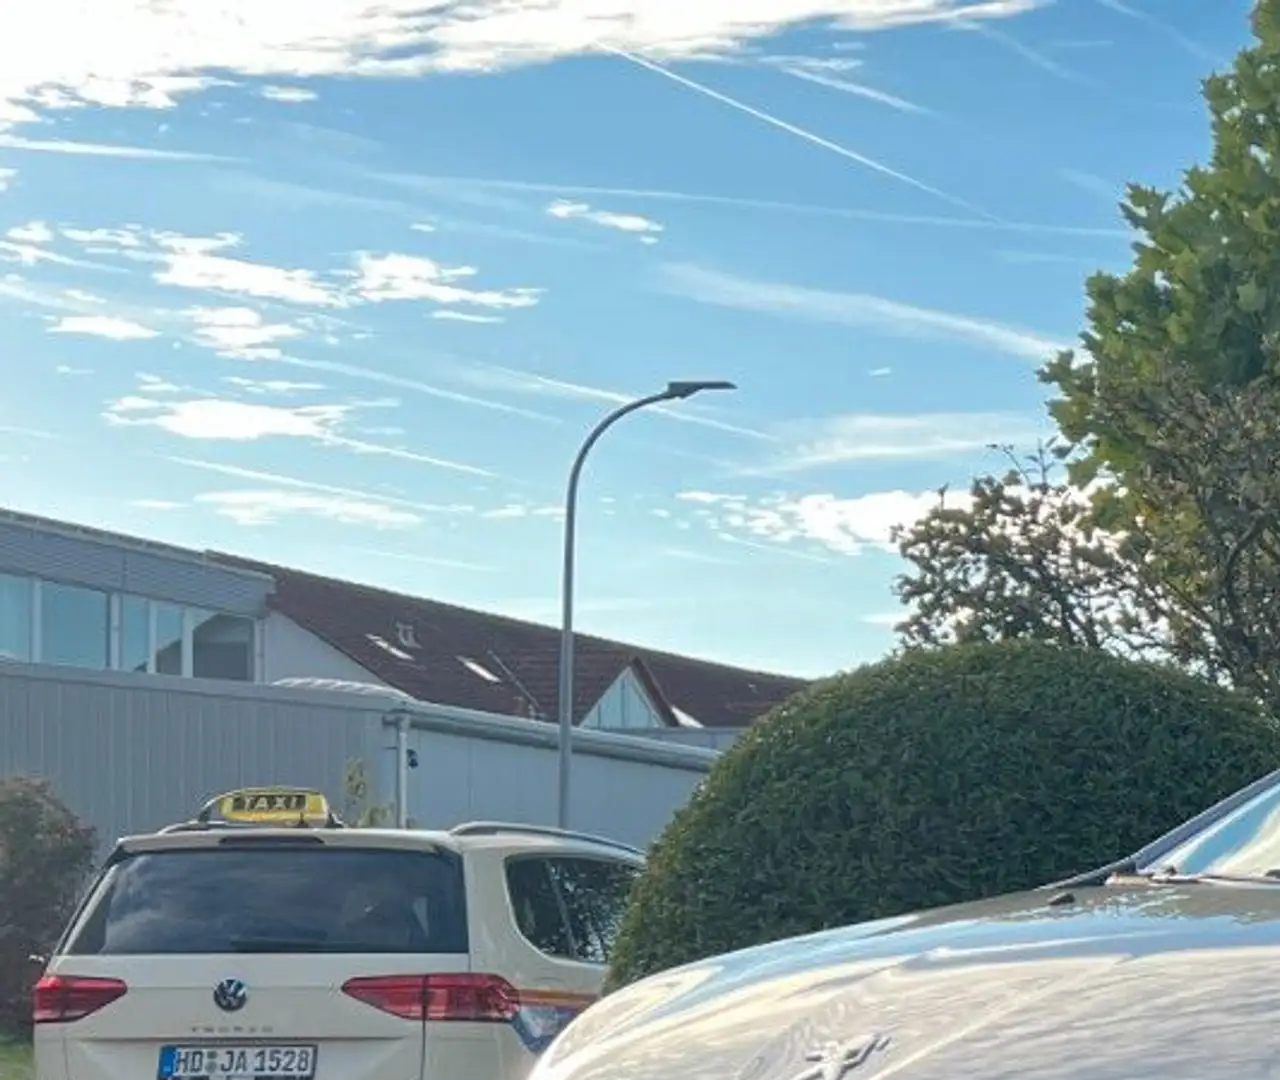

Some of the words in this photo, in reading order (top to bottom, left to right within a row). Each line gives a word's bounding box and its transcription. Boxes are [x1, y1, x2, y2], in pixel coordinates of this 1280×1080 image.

[243, 796, 298, 812] TAXI
[176, 1050, 205, 1073] HD
[220, 1050, 248, 1073] JA
[254, 1050, 311, 1073] 1528
